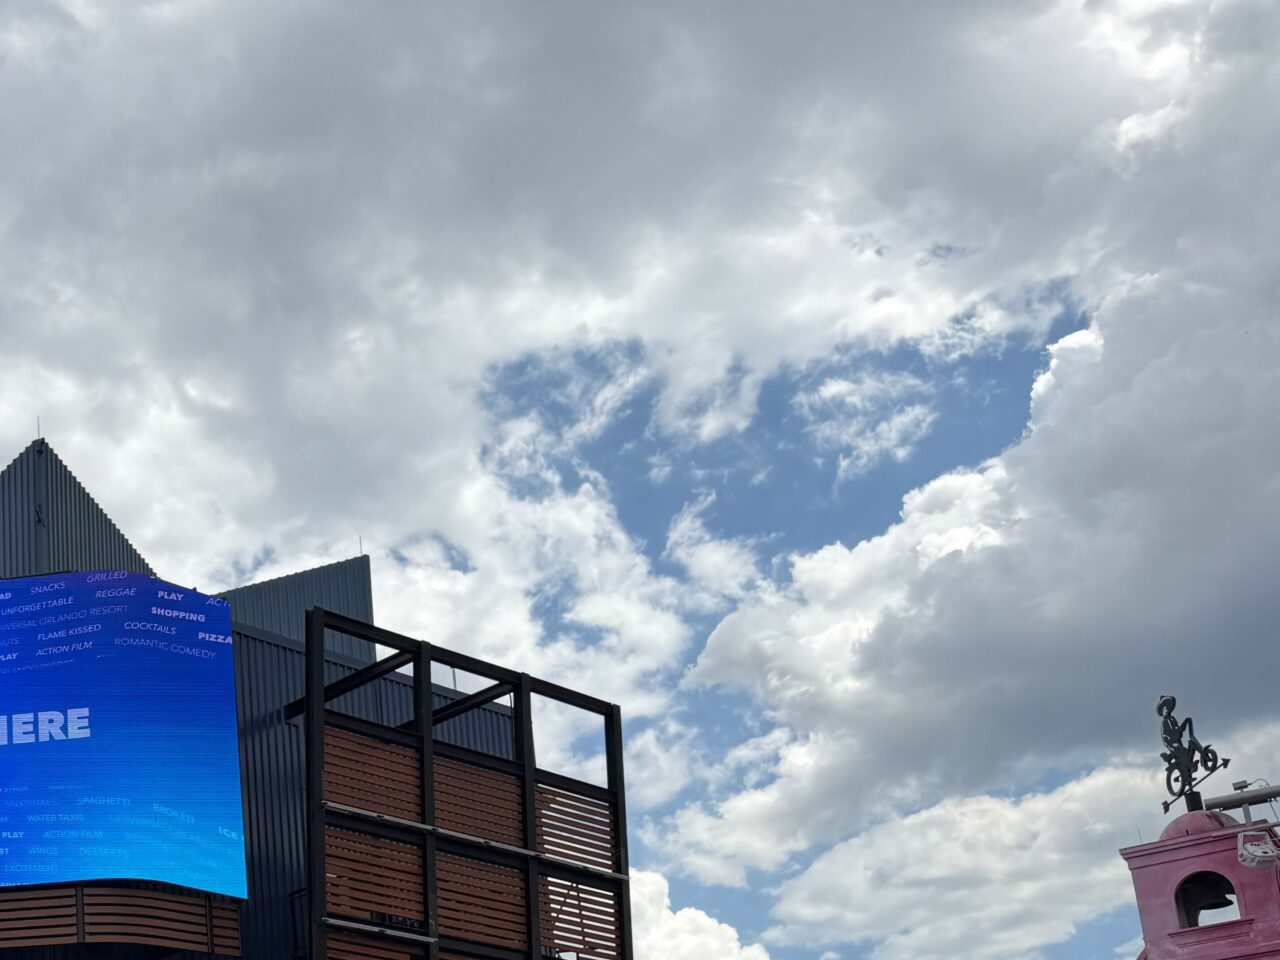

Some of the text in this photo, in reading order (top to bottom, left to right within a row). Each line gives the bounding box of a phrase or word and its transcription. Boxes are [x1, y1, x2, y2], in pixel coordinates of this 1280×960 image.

[87, 571, 128, 583] GRILLED
[30, 581, 66, 596] SNACKS
[95, 587, 137, 599] REGGAE
[158, 590, 185, 601] PLAY
[1, 596, 75, 616] UNFORGETTABLE
[39, 611, 87, 626] ORLANDO
[89, 604, 129, 618] RESORT
[151, 606, 206, 623] SHOPPING
[37, 623, 102, 641] FLAME KISSED
[124, 621, 177, 635] COCKTAILS
[198, 631, 233, 645] PIZZA
[35, 640, 94, 656] ACTION FILM
[114, 637, 217, 660] ROMANTIC COMEDY
[78, 796, 131, 806] SPAGHETTI
[2, 831, 25, 839] PLAY
